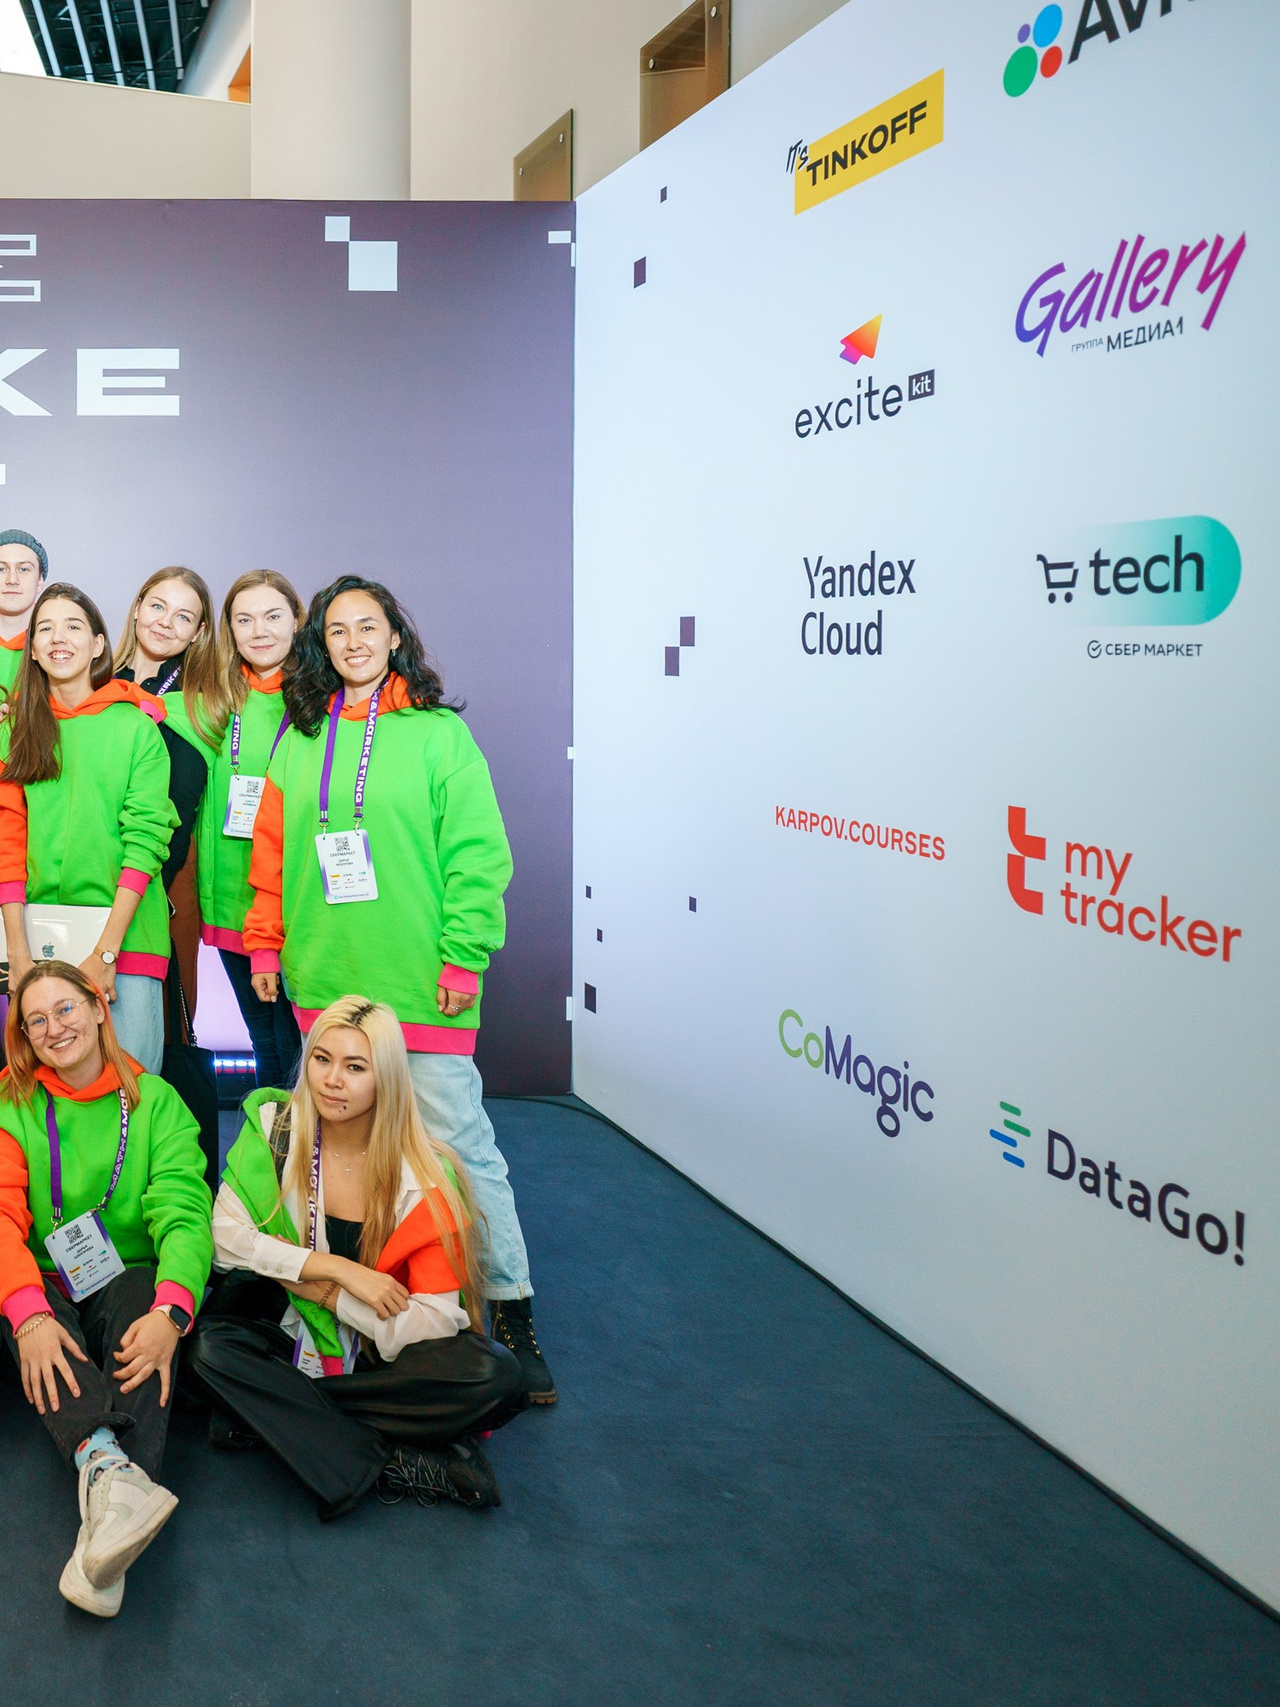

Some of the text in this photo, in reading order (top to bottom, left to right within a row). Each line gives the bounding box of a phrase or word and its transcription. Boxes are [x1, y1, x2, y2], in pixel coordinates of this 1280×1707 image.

[806, 99, 928, 186] TINKOFF
[1014, 231, 1247, 357] Gallery
[1071, 315, 1184, 353] ГРУППА МЕДИА1
[794, 374, 932, 439] excite kit
[802, 550, 917, 599] Yandex
[1088, 534, 1205, 596] tech
[800, 609, 884, 656] Cloud
[1104, 642, 1204, 657] СБЕР МАРКЕТ
[775, 804, 946, 861] KARPOV.COURSES
[1064, 840, 1134, 896] my
[1060, 881, 1242, 963] tracker
[778, 1008, 935, 1138] CoMagic
[1046, 1128, 1246, 1267] DataGo!
